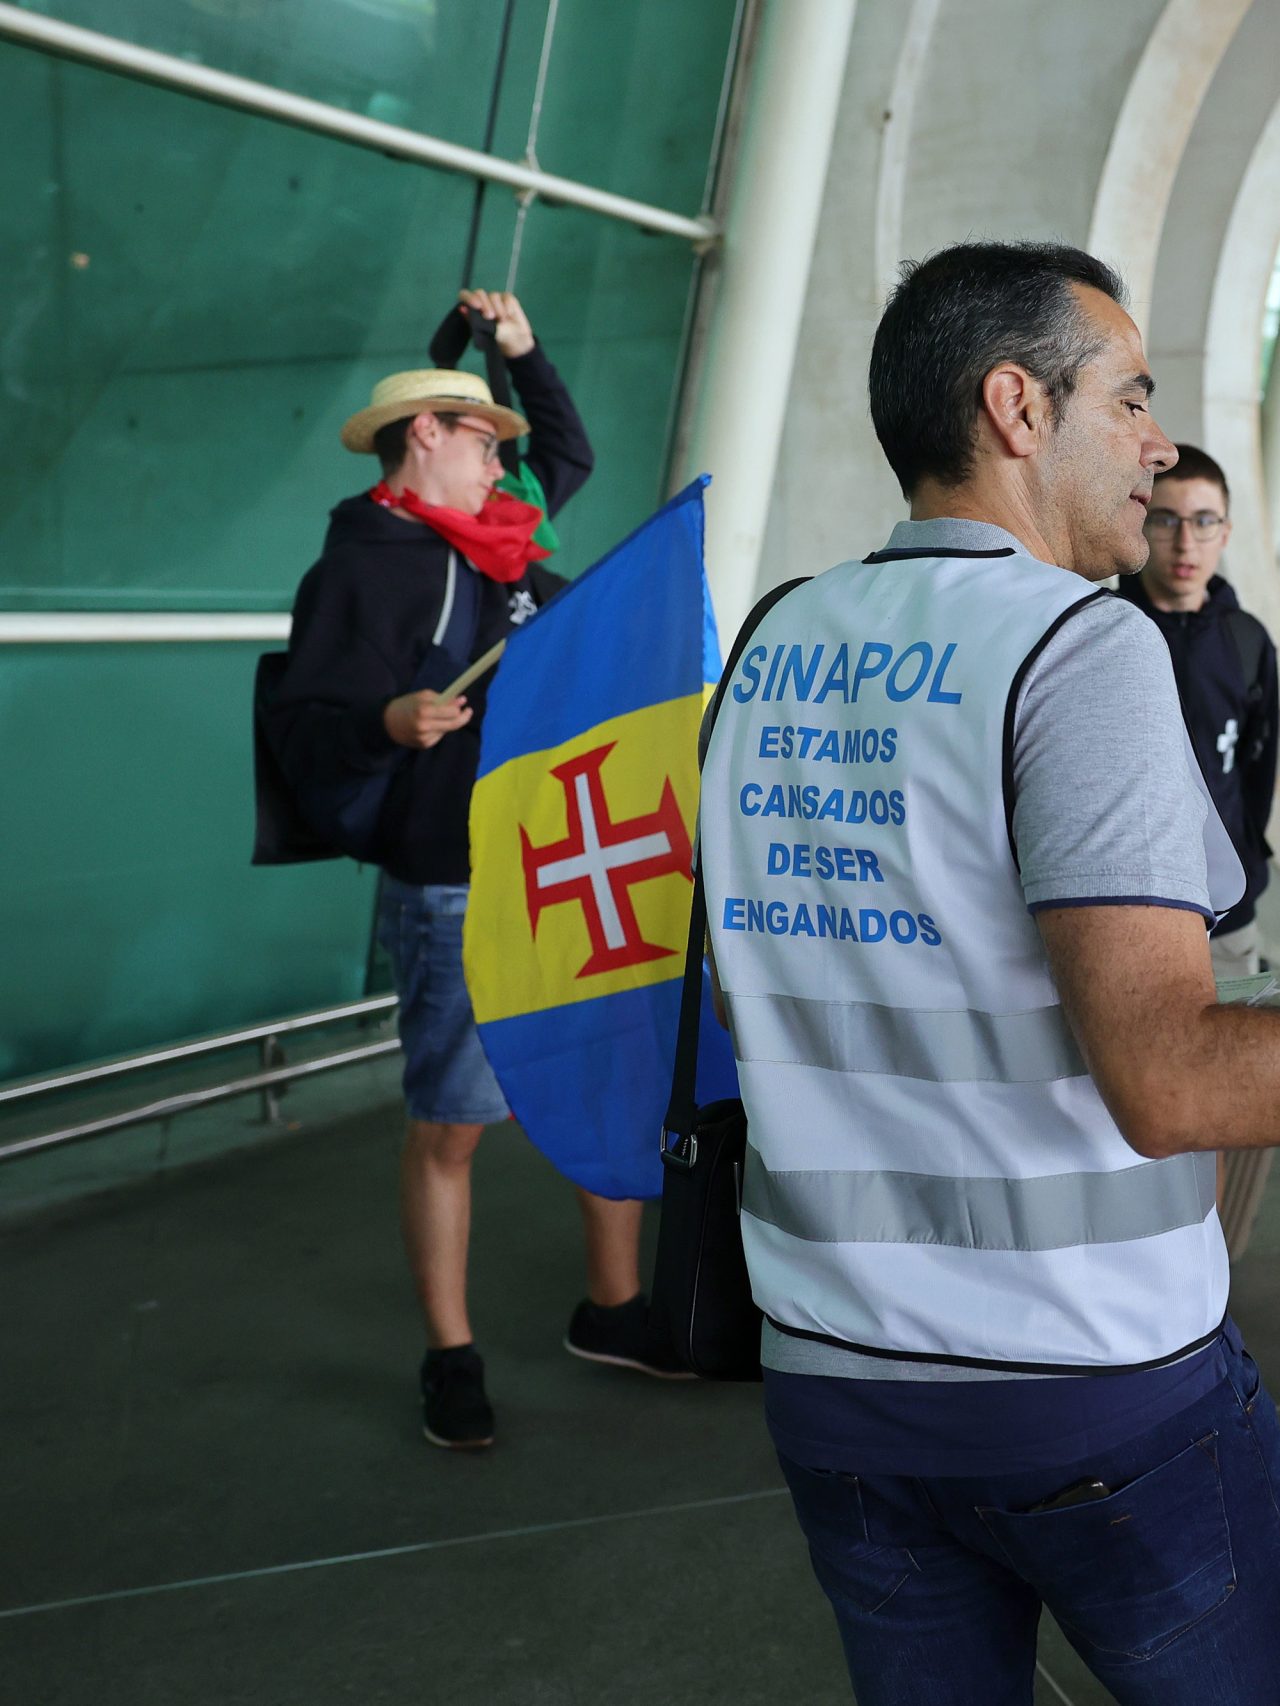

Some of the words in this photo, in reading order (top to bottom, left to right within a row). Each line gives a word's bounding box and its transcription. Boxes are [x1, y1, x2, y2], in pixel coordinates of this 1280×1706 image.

[732, 641, 963, 704] SINAPOL
[758, 726, 898, 764] ESTAMOS
[739, 783, 906, 826] CANSADOS
[722, 898, 943, 946] ENGANADOS
